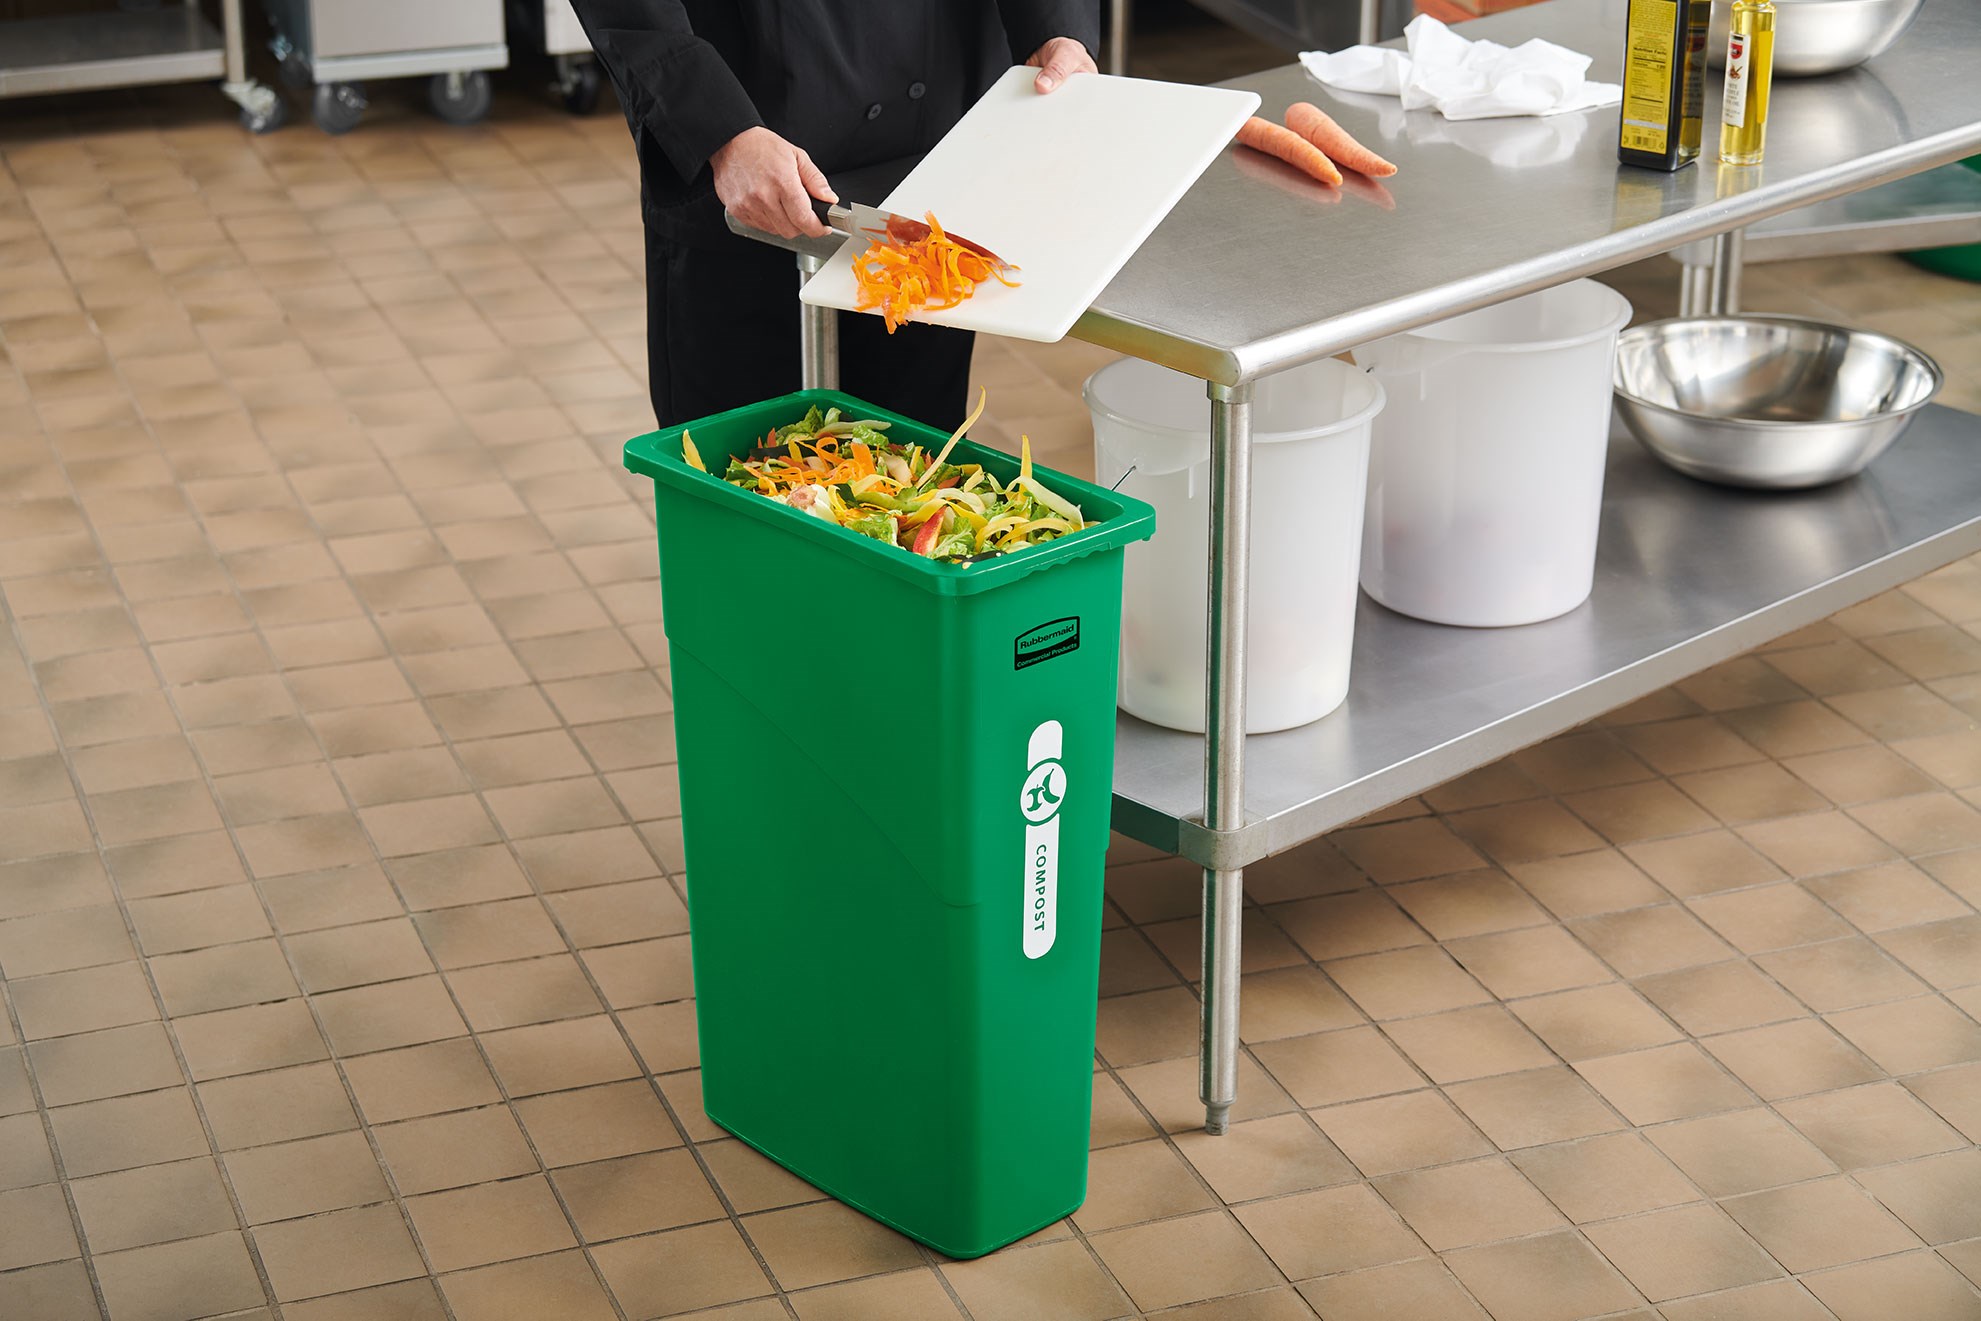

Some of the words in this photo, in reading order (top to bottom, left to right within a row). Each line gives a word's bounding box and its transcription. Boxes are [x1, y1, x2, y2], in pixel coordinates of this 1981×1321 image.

[1020, 624, 1074, 649] Rubbermaid
[1017, 651, 1050, 668] Commercial
[1051, 643, 1077, 656] Products
[1034, 844, 1047, 931] COMPOST
